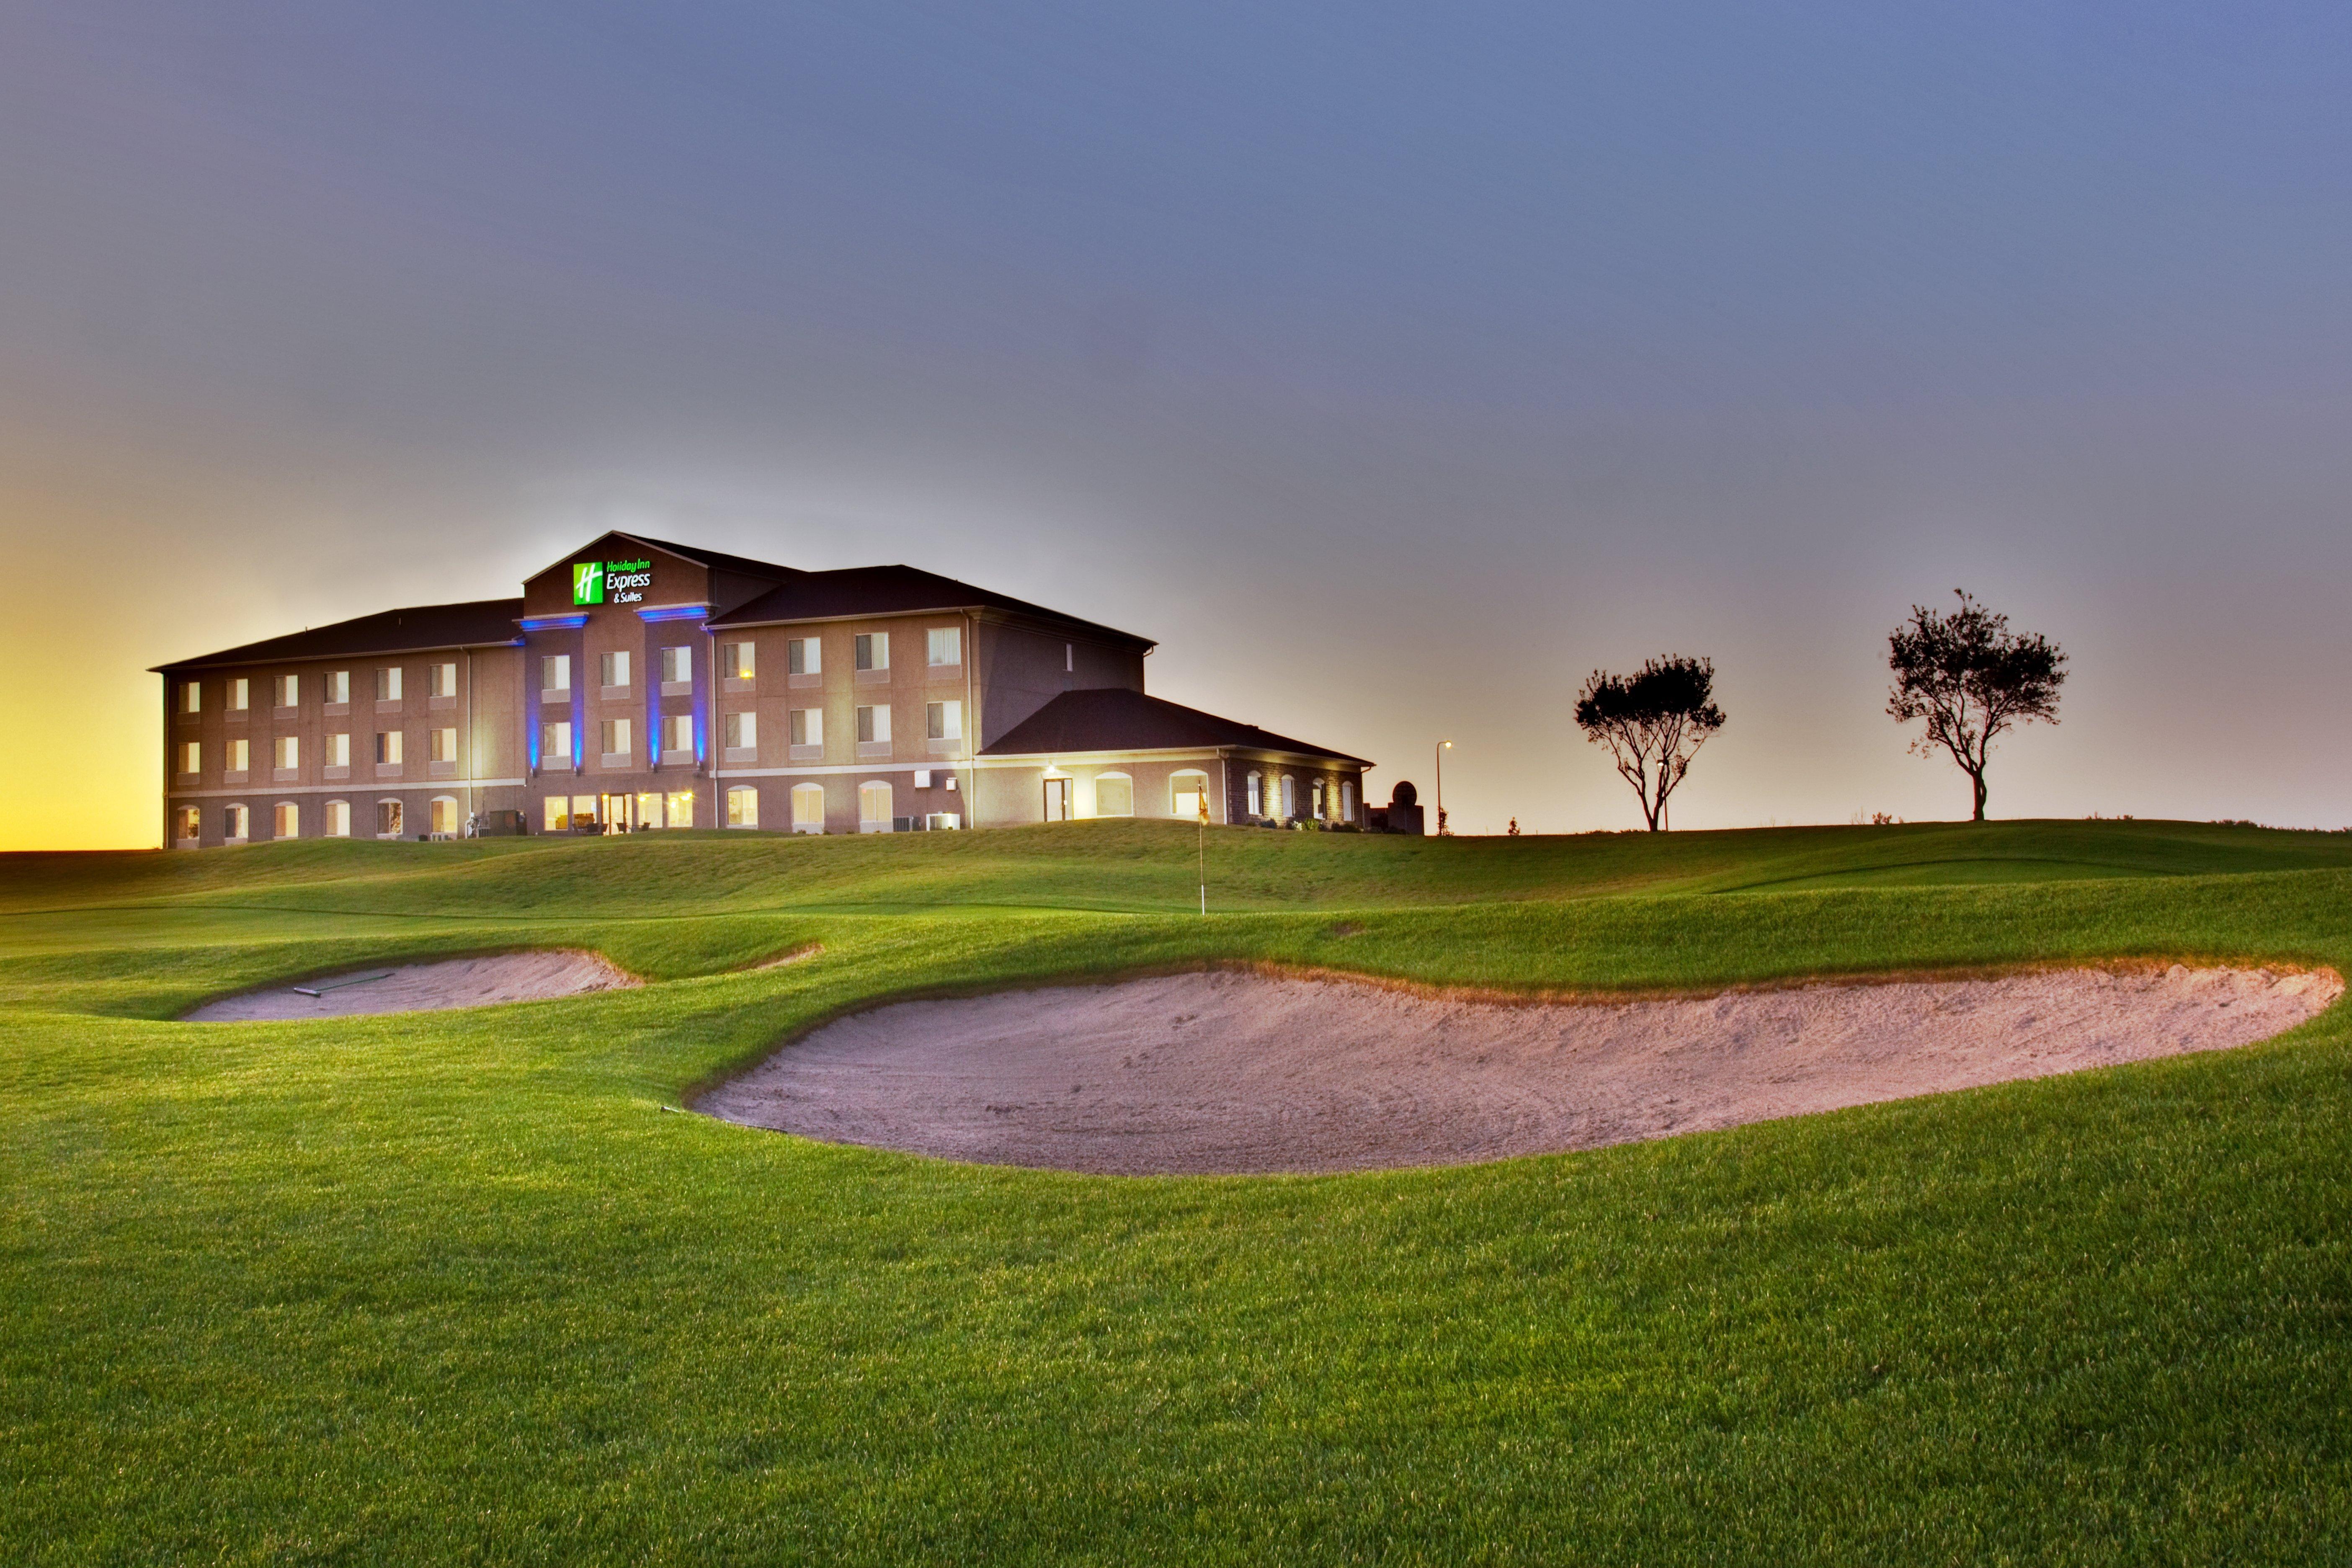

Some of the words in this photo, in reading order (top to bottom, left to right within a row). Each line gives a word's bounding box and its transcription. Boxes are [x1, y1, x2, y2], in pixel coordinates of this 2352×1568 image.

[607, 560, 637, 573] Holiday
[637, 558, 650, 569] Inn
[606, 573, 650, 592] Express
[614, 593, 619, 603] &
[620, 592, 642, 603] Suites
